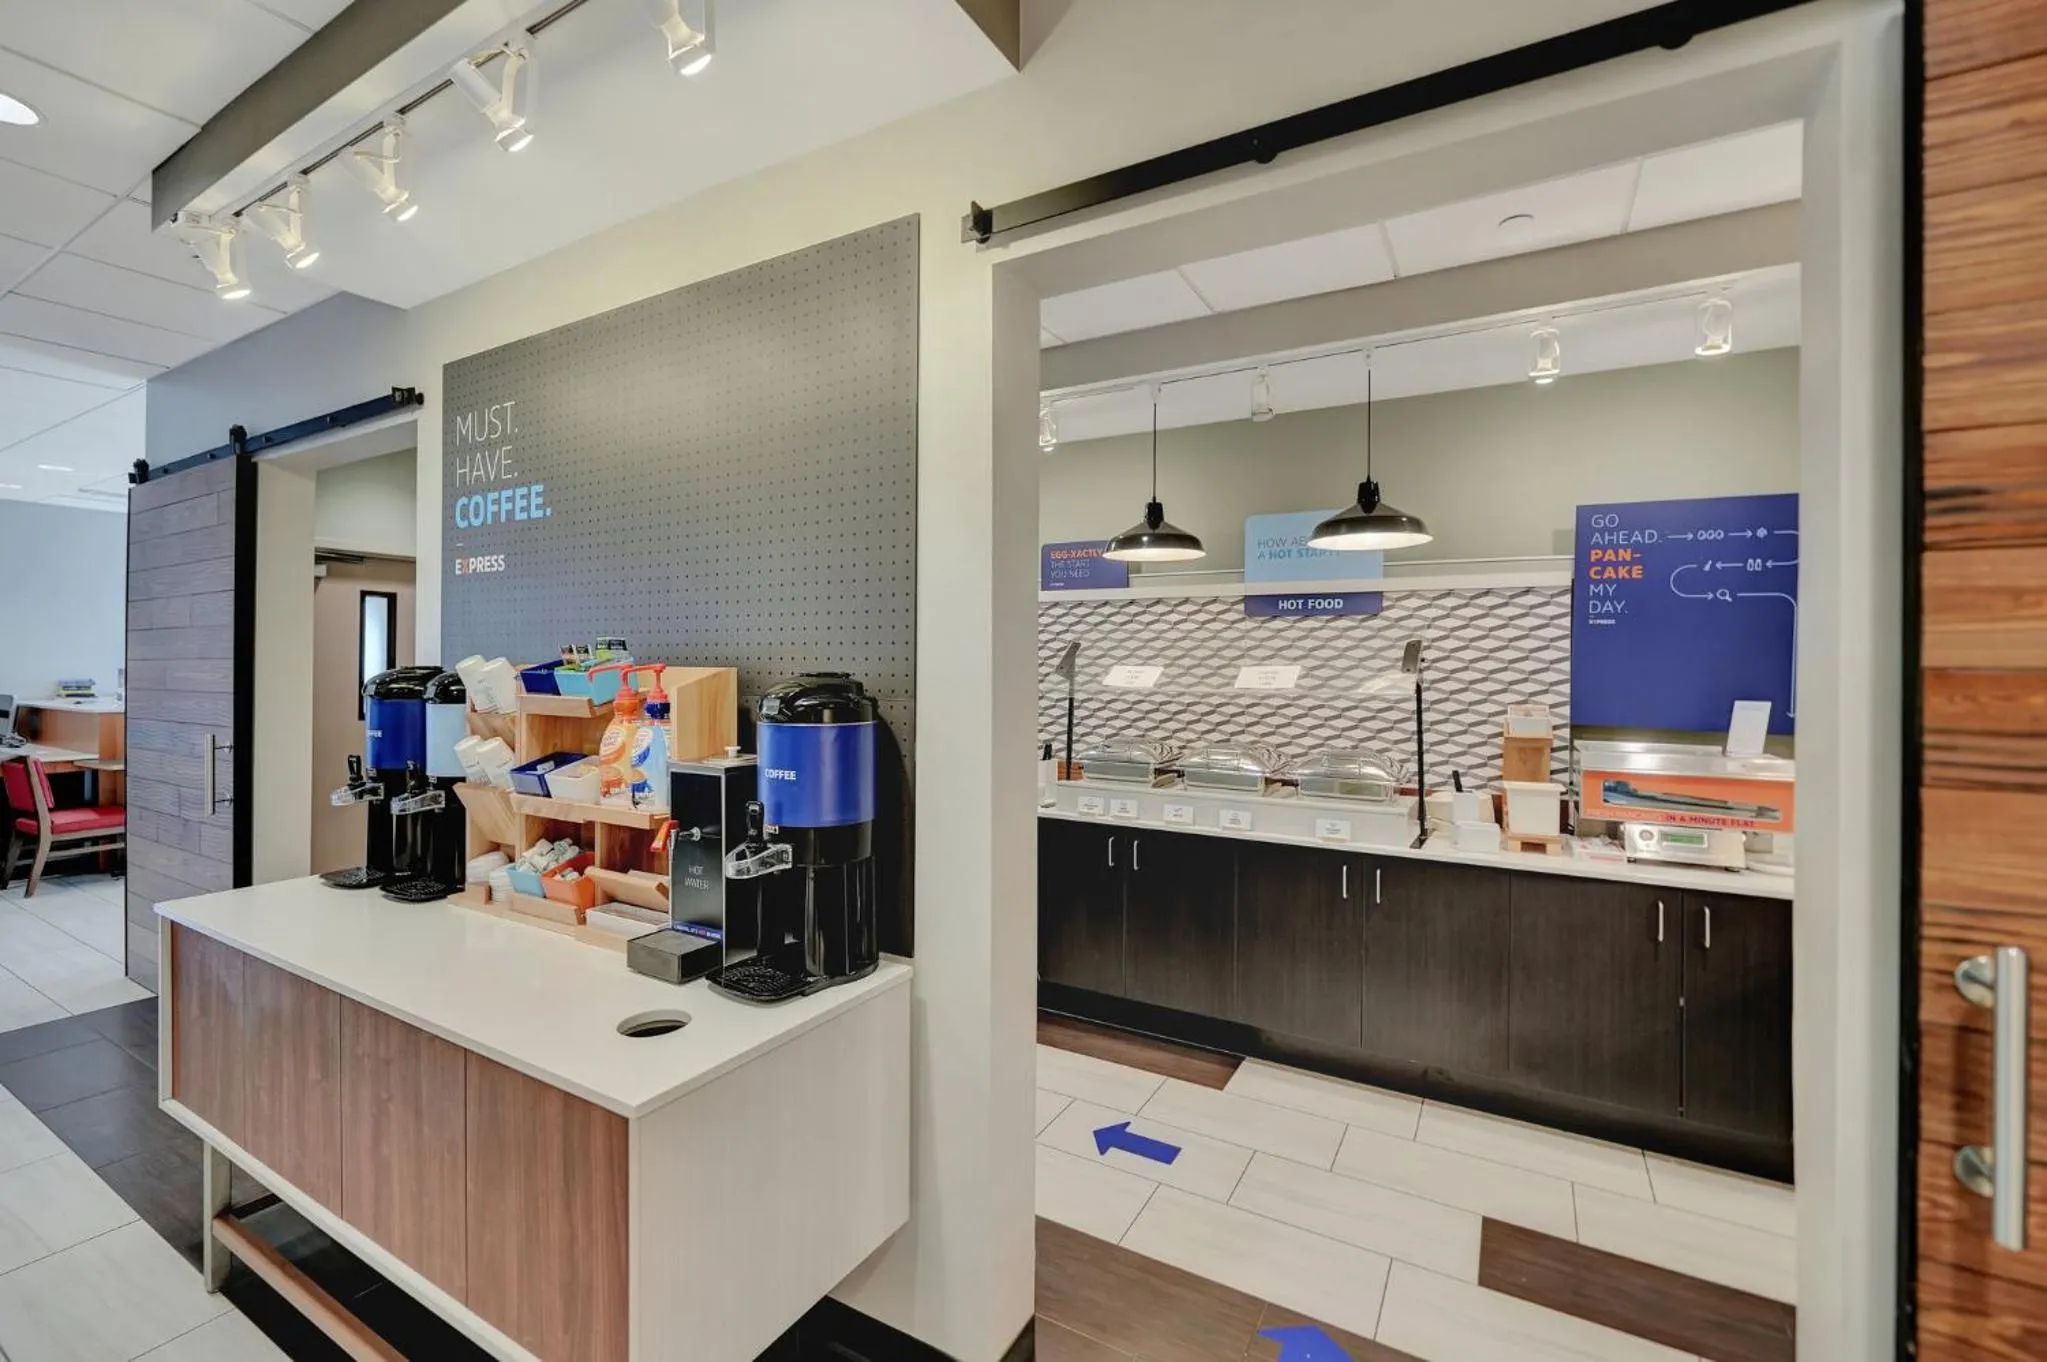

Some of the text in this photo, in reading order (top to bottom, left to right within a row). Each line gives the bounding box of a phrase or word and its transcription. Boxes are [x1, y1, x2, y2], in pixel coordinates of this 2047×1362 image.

[456, 401, 519, 447] MUST.
[456, 445, 519, 488] HAVE.
[455, 484, 552, 528] COFFEE.
[1591, 514, 1619, 528] GO
[1257, 536, 1288, 550] HOW
[1590, 530, 1662, 545] AHEAD.
[1268, 549, 1292, 560] HOT
[1589, 548, 1641, 563] PAN-
[455, 554, 506, 575] EXPRESS
[1589, 565, 1643, 579] CAKE
[1588, 583, 1617, 597] MY
[1278, 598, 1344, 610] HOT FOOD
[1588, 599, 1628, 615] DAY.
[765, 768, 797, 780] COFFEE
